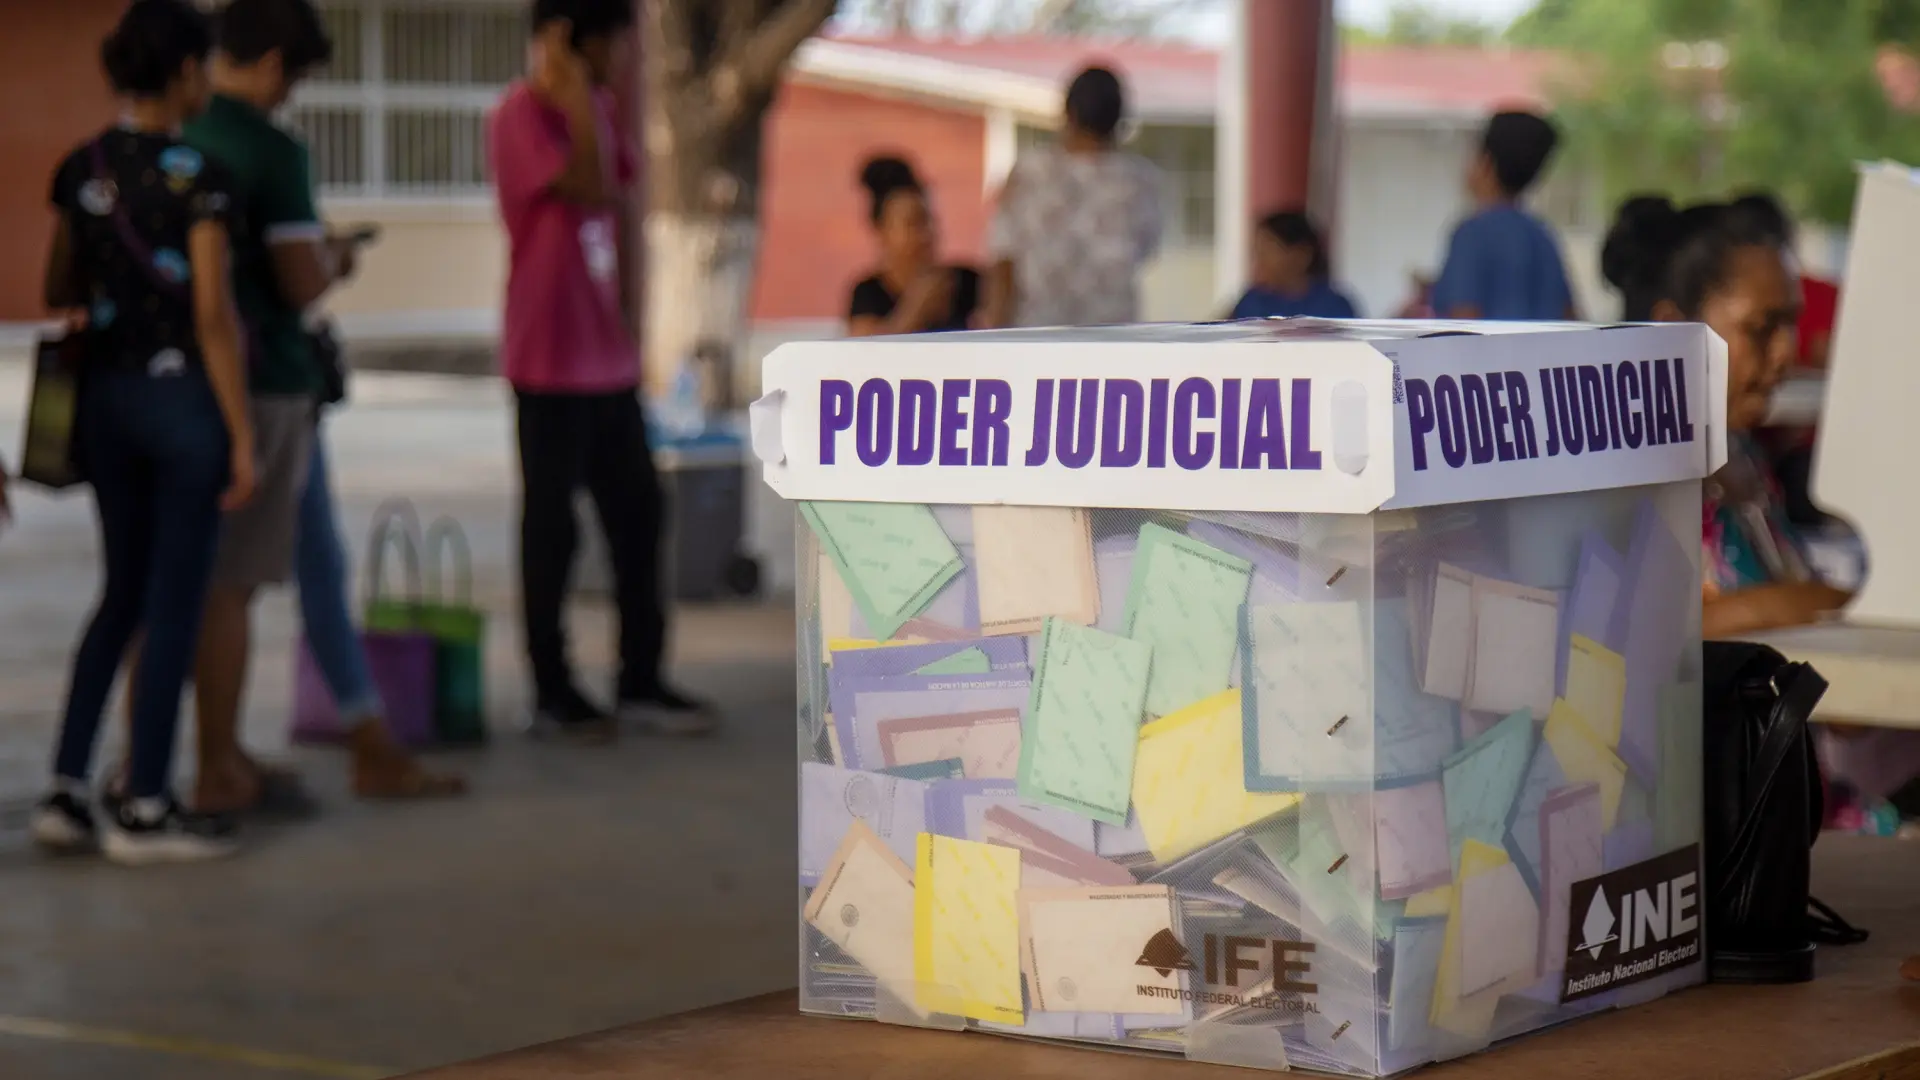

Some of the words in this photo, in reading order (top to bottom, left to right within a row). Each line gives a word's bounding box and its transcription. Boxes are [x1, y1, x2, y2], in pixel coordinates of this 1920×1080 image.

[819, 377, 1013, 467] PODER
[1025, 377, 1323, 471] JUDICIAL
[1404, 370, 1539, 471] PODER
[1539, 358, 1694, 457] JUDICIAL
[1620, 871, 1698, 954] INE
[1136, 984, 1191, 1000] INSTITUTO
[1196, 991, 1248, 1006] FEDERAL
[1250, 997, 1321, 1013] ELECTORAL
[1204, 933, 1318, 994] IFE
[1567, 972, 1610, 995] Instituto
[1612, 954, 1657, 980] Nacional
[1658, 938, 1698, 966] Electoral
